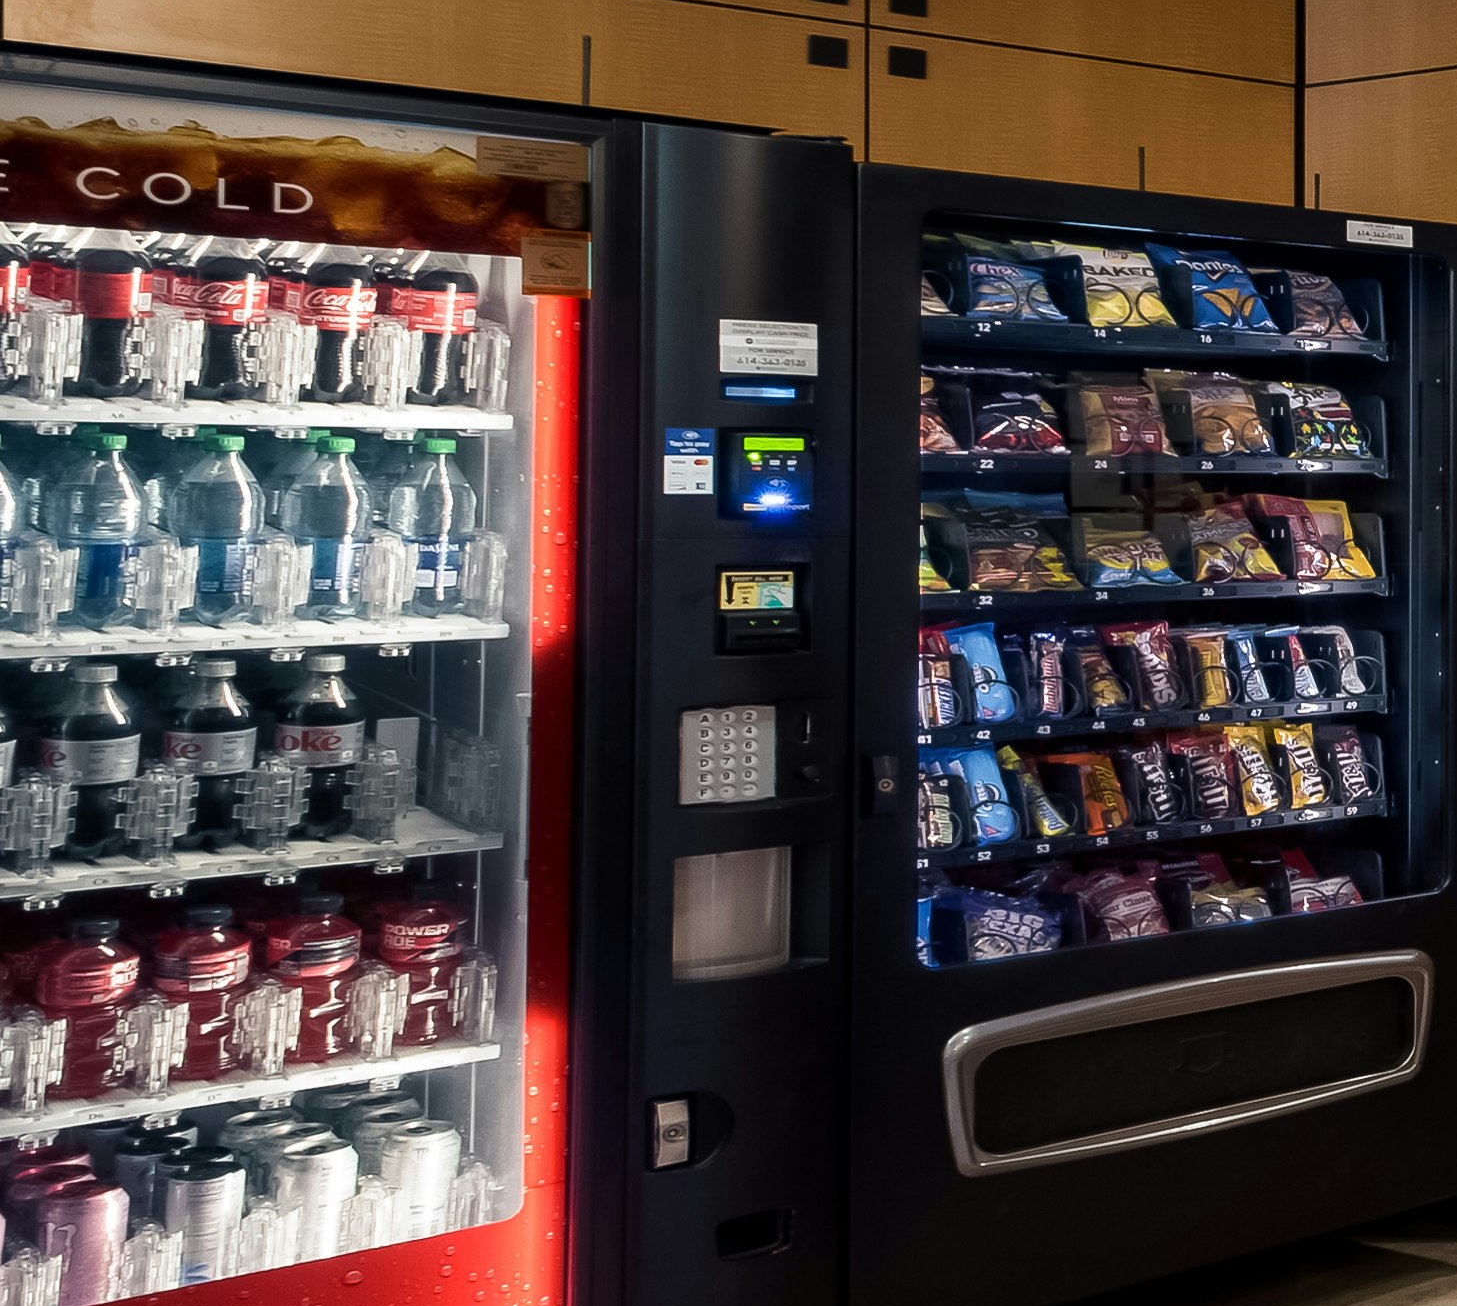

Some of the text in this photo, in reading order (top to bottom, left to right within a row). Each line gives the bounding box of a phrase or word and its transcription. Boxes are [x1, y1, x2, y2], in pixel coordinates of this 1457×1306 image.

[76, 167, 313, 214] COLD
[969, 262, 1023, 277] Chex
[977, 322, 991, 333] 12
[1093, 329, 1106, 338] 14
[1201, 334, 1213, 344] 16
[737, 356, 807, 368] 614-363-0135
[980, 459, 994, 469] 22
[1094, 460, 1108, 469] 24
[1201, 461, 1214, 470] 26
[1095, 591, 1108, 601] 34
[1202, 587, 1215, 597] 36
[979, 595, 993, 605] 32
[973, 662, 990, 694] OREO
[1346, 701, 1358, 710] 49
[700, 715, 710, 723] A
[745, 712, 753, 720] 2
[1198, 712, 1211, 722] 46
[1250, 708, 1262, 717] 47
[1092, 721, 1106, 730] 44
[1132, 717, 1146, 727] 45
[700, 729, 708, 738] B
[723, 728, 730, 736] 3
[976, 730, 991, 740] 42
[1037, 725, 1051, 735] 43
[277, 731, 342, 752] oke
[700, 741, 752, 752] C 5 6
[700, 756, 752, 767] D 7 8
[700, 770, 752, 782] E 9 0
[700, 788, 708, 797] F
[1346, 806, 1358, 815] 59
[1250, 818, 1262, 827] 57
[1200, 824, 1213, 833] 56
[1146, 830, 1159, 840] 55
[1096, 837, 1109, 846] 54
[1036, 844, 1050, 854] 53
[977, 851, 992, 861] 52
[385, 923, 450, 936] POWER
